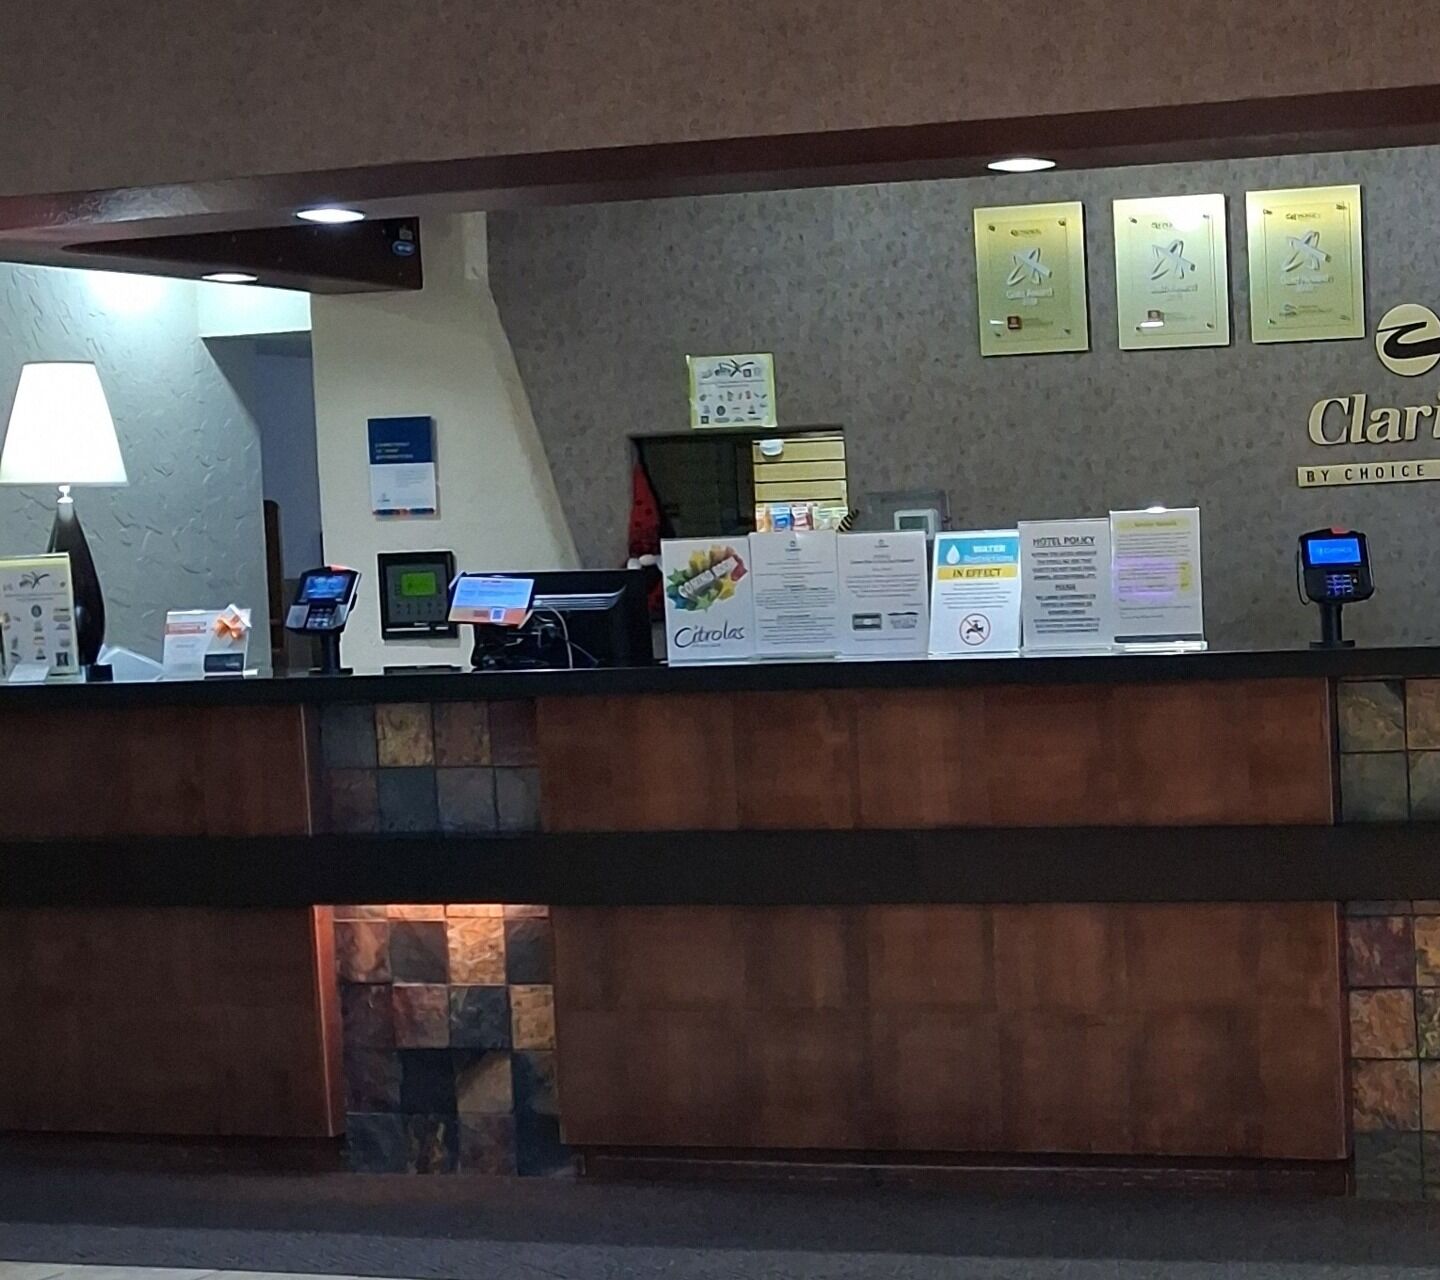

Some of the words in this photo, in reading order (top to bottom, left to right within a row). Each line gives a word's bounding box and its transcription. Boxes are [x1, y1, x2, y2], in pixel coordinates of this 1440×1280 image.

[1306, 469, 1330, 483] BY
[1344, 464, 1424, 481] CHOICE
[1033, 537, 1061, 546] HOTEL
[1063, 536, 1096, 545] POLICY
[952, 569, 966, 577] IN
[966, 568, 1003, 577] EFFECT
[674, 621, 745, 648] Citrolas
